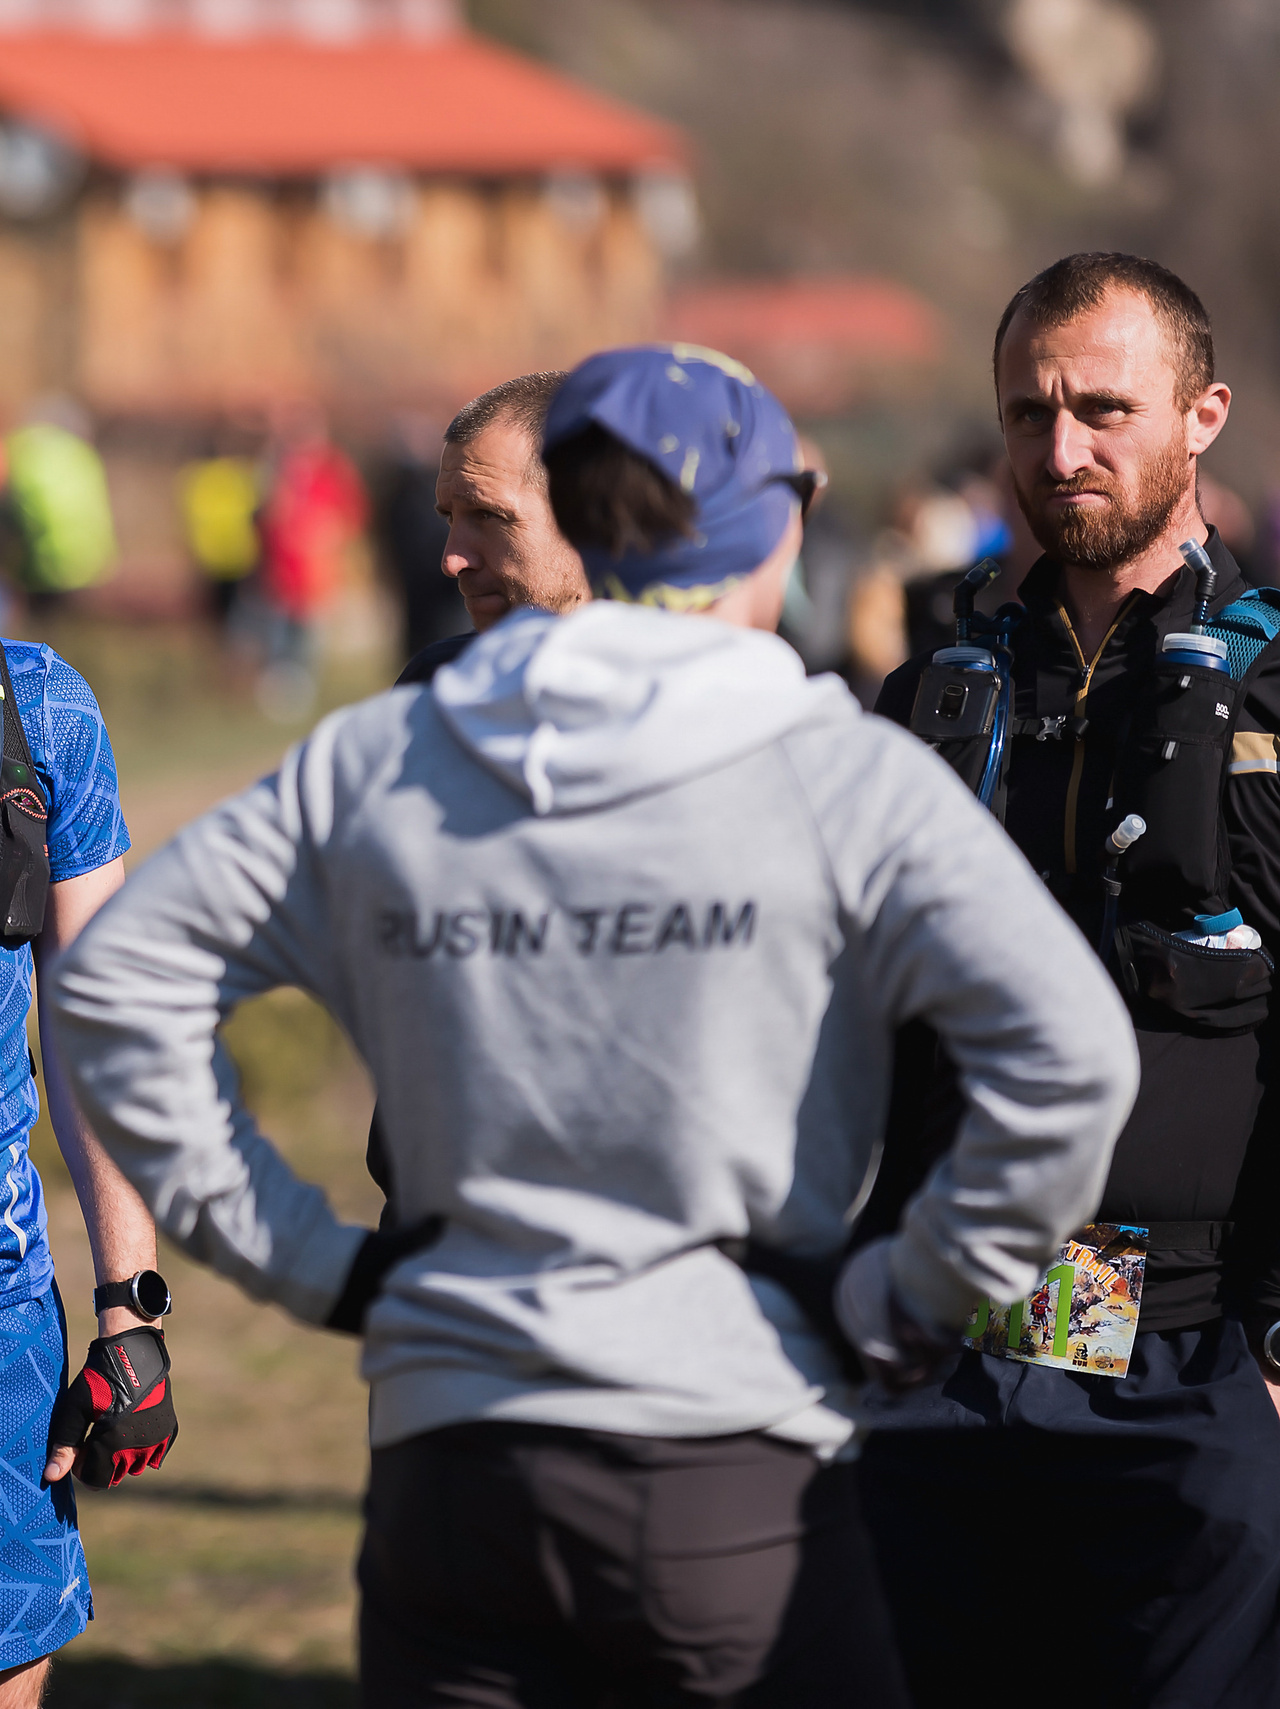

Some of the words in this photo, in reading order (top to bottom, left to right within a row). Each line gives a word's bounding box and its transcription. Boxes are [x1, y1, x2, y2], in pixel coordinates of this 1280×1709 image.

[377, 905, 549, 960] RUSIN
[573, 899, 759, 958] TEAM
[1067, 1239, 1121, 1294] TRAIL
